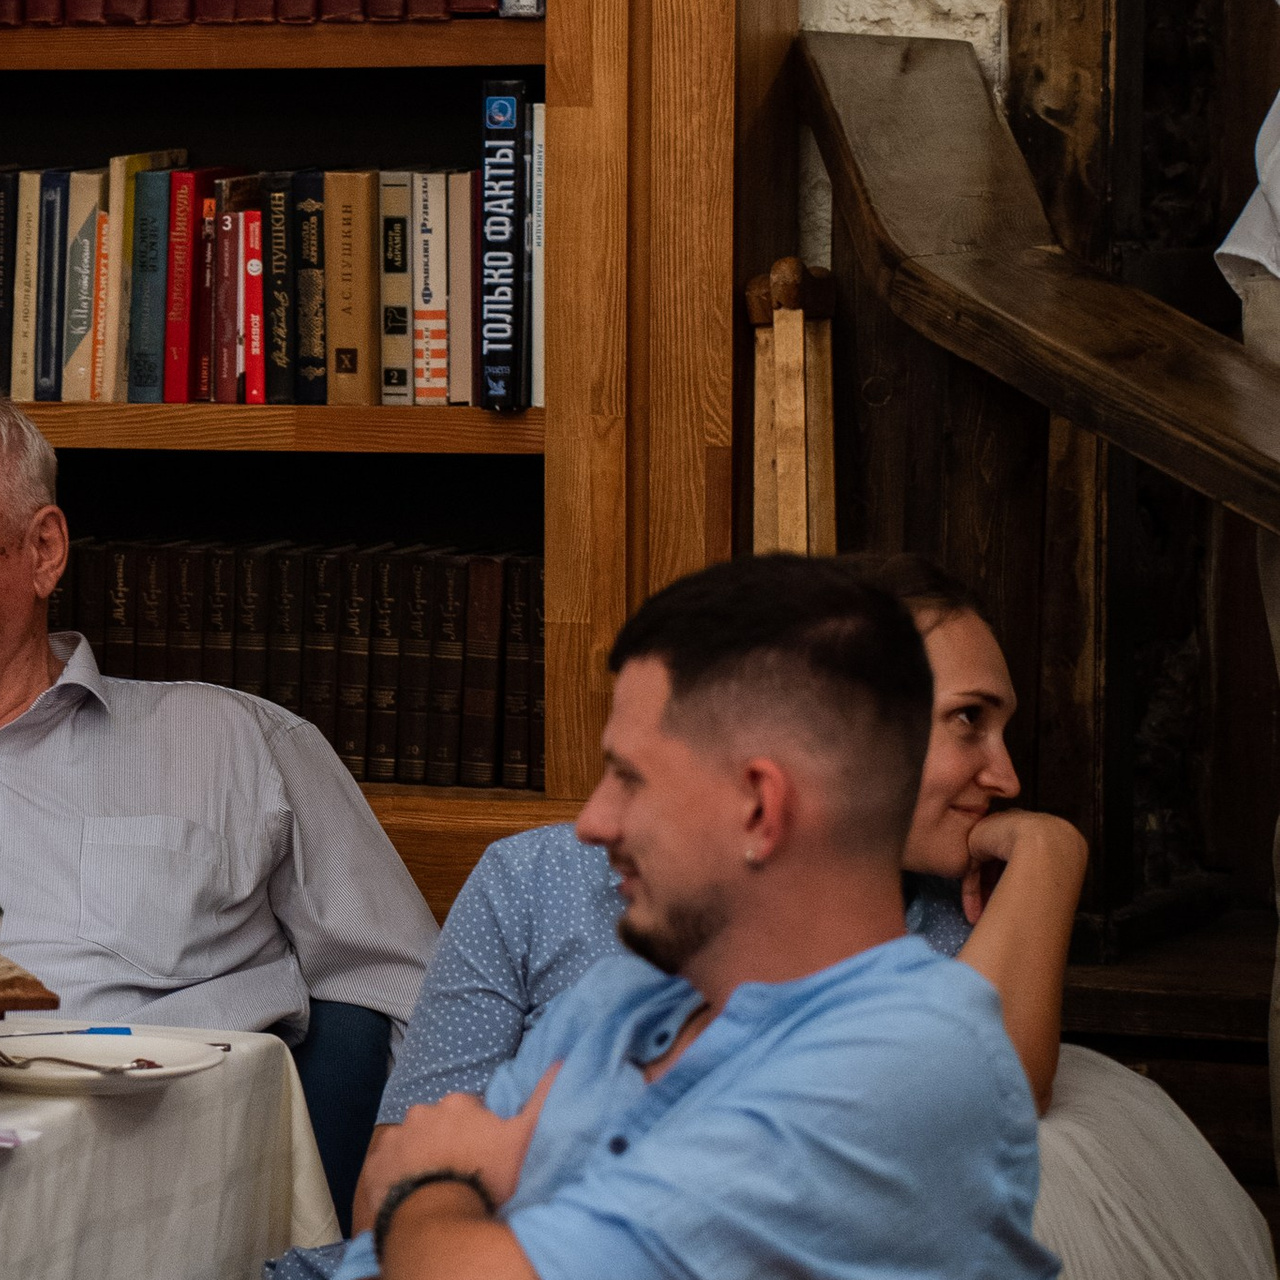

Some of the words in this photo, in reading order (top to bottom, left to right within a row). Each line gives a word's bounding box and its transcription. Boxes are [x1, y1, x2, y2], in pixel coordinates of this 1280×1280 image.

[171, 184, 189, 243] Пикуль
[221, 215, 233, 231] 3
[481, 139, 514, 243] ФАКТЫ
[535, 180, 544, 248] ЦИВИЛИЗАЦИИ
[270, 191, 286, 275] ПУШКИН
[341, 203, 354, 283] ПУШКИН
[393, 222, 403, 268] АБРАМОВ
[96, 257, 109, 342] РАССКАЖУТ
[167, 244, 187, 322] Валентин
[481, 250, 514, 356] ТОЛЬКО
[94, 344, 105, 395] УЛИЦЫ
[389, 371, 400, 384] 2
